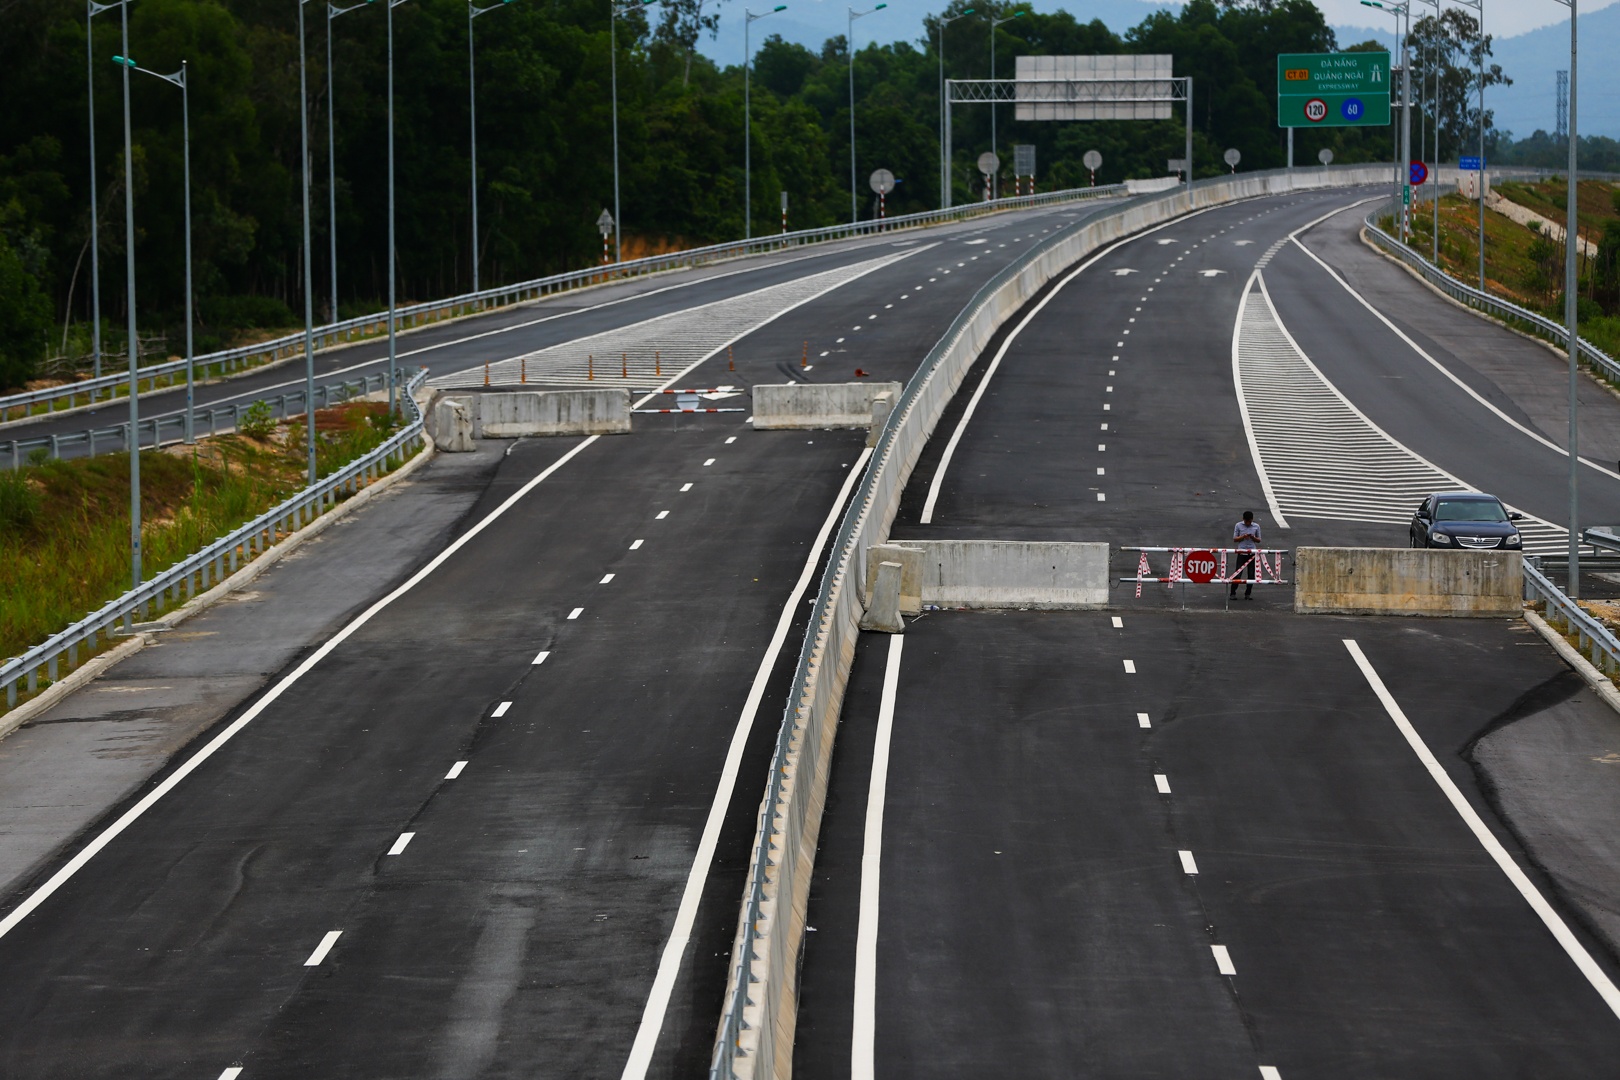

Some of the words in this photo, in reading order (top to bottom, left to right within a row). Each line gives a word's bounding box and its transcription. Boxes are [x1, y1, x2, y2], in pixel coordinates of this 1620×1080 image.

[1287, 71, 1297, 79] CT
[1299, 71, 1307, 79] 01
[1308, 105, 1323, 115] 120
[1347, 104, 1357, 114] 60
[1188, 560, 1214, 574] STOP
